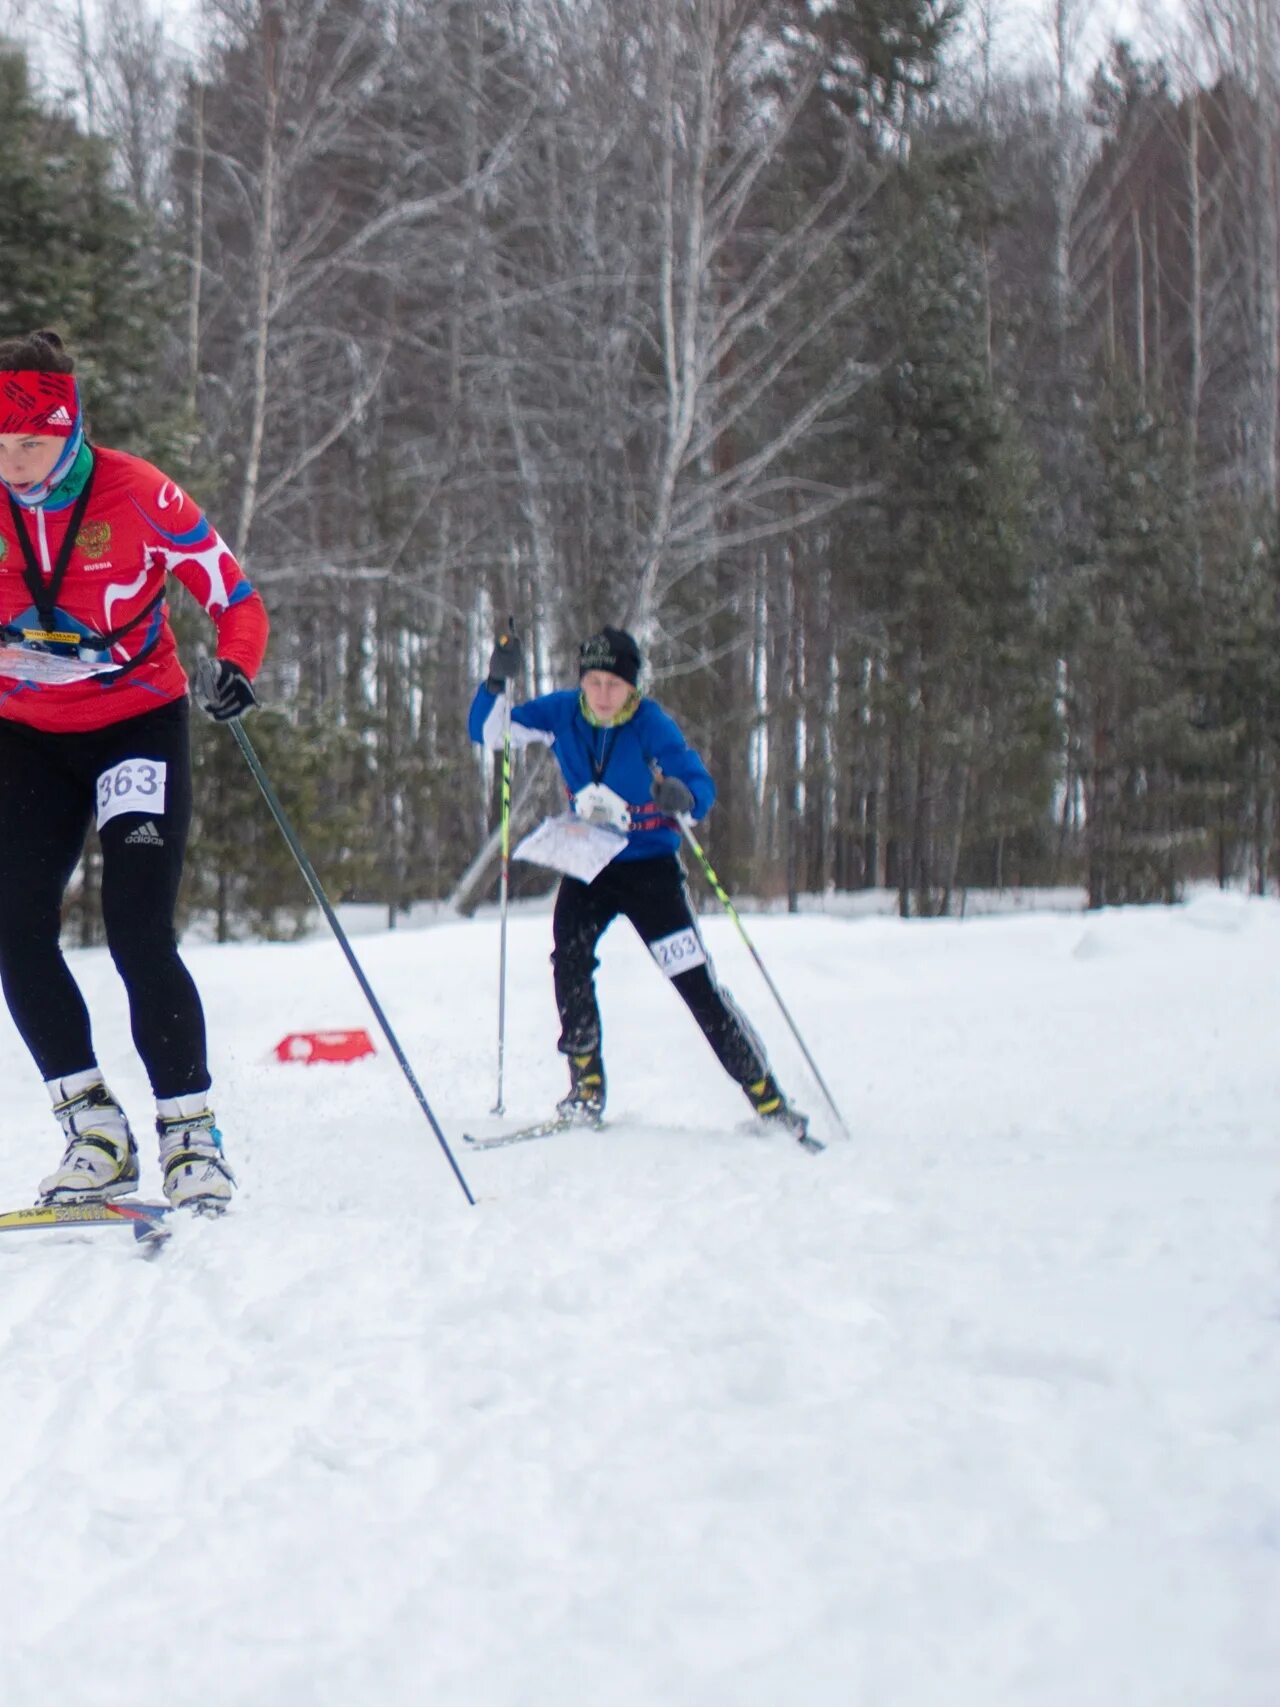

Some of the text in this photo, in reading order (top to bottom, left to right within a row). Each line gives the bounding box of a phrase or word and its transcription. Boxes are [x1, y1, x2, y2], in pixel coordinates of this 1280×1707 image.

[83, 562, 112, 572] RUSSIA
[100, 765, 158, 807] 363
[125, 835, 164, 846] adidas
[660, 935, 697, 966] 263
